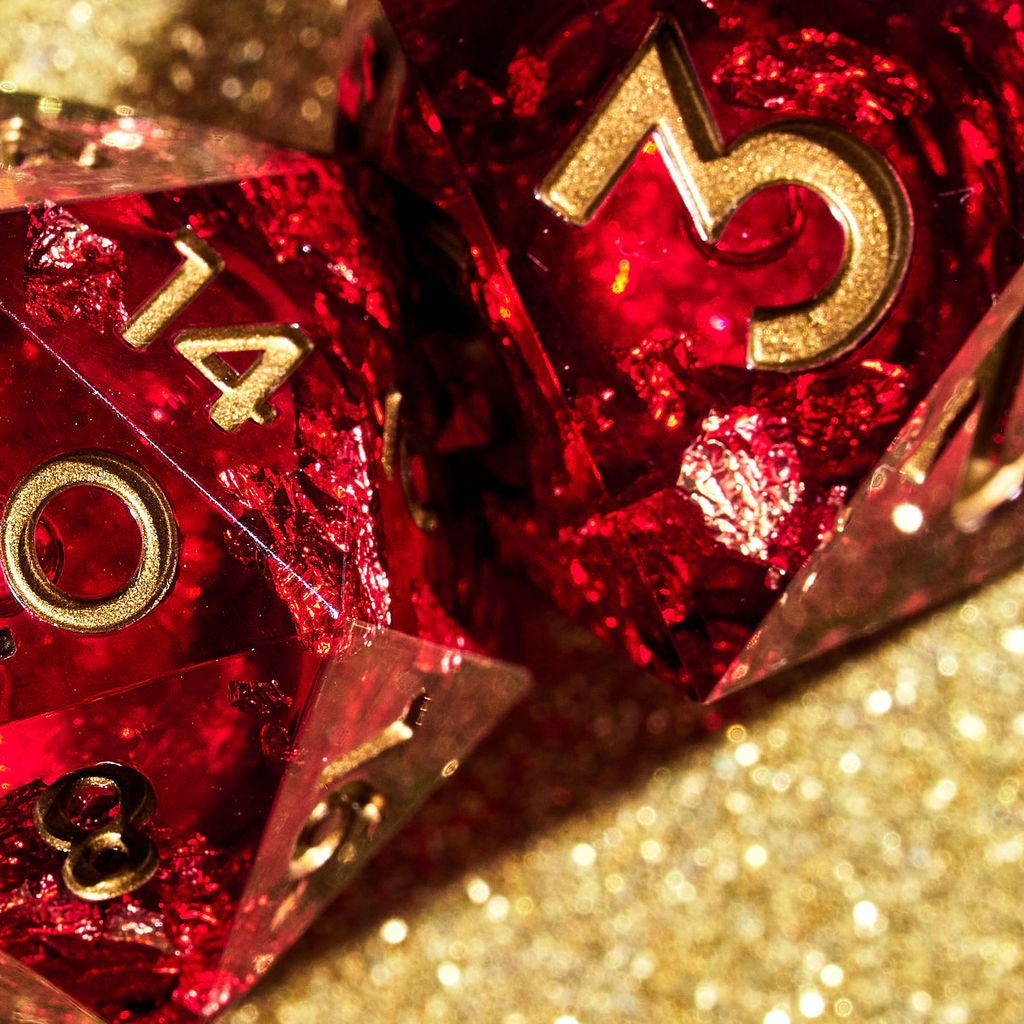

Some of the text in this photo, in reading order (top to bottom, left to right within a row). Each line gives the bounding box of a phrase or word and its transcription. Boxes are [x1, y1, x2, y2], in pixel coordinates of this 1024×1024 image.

[535, 14, 914, 372] 3
[121, 226, 314, 433] 14
[34, 760, 159, 900] 8
